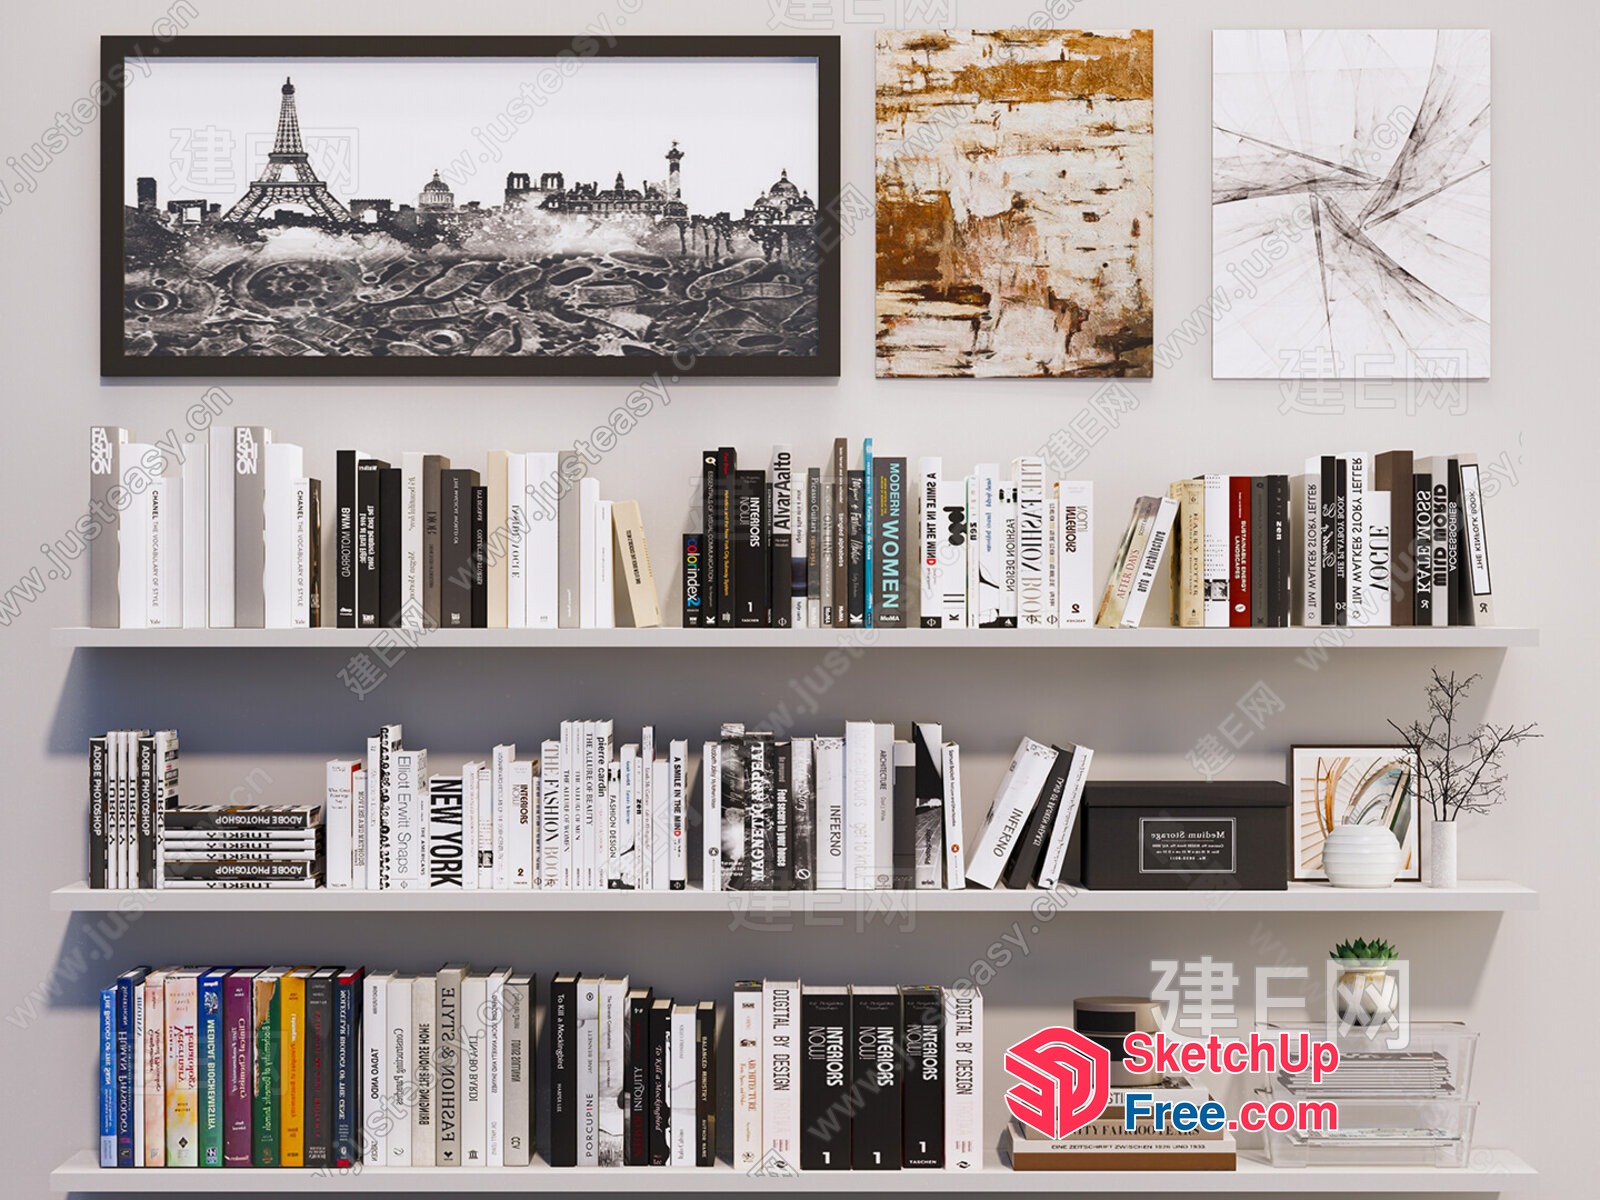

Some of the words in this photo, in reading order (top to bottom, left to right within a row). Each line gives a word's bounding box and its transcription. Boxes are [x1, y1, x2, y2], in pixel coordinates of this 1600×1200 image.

[773, 452, 791, 531] AlvarAalto
[890, 463, 900, 516] MODERN
[750, 497, 760, 548] INTERIORS
[687, 539, 701, 607] colorindex2
[882, 520, 899, 609] WOMEN
[1116, 572, 1133, 599] AFTER
[1127, 549, 1140, 572] DAYS
[93, 745, 102, 778] ADOBE
[141, 745, 150, 778] ADOBE
[597, 737, 607, 765] pierre
[396, 756, 411, 789] Elliott
[597, 767, 607, 798] cardin
[93, 779, 102, 836] PHOTOSHOP
[141, 779, 150, 836] PHOTOSHOP
[396, 793, 411, 828] Erwitt
[430, 780, 463, 825] NEW
[520, 784, 528, 825] INTERIORS
[674, 789, 681, 798] IN
[777, 789, 787, 802] Feel
[215, 816, 270, 824] PHOTOSHOP
[272, 816, 303, 824] ADOBE
[777, 803, 787, 824] secure
[777, 832, 787, 847] your
[830, 805, 841, 857] INFERNO
[993, 807, 1024, 858] INFERNO
[215, 866, 270, 874] PHOTOSHOP
[272, 866, 303, 874] ADOBE
[396, 832, 411, 874] Snaps
[430, 831, 463, 888] YORK
[777, 847, 787, 867] house
[555, 994, 565, 1003] To
[555, 1004, 565, 1016] Kill
[773, 989, 790, 1030] DIGITAL
[956, 998, 973, 1036] DIGITAL
[555, 1024, 565, 1070] Mockingbird
[773, 1035, 790, 1048] BY
[809, 1027, 825, 1060] NOW!
[827, 1027, 843, 1087] INTERIORS
[860, 1027, 876, 1060] NOW!
[878, 1027, 893, 1087] INTERIORS
[906, 1025, 922, 1056] NOW!
[923, 1025, 938, 1081] INTERIORS
[956, 1042, 973, 1054] BY
[633, 1066, 643, 1112] INIQUITY
[773, 1053, 790, 1091] DESIGN
[956, 1060, 973, 1096] DESIGN
[823, 1152, 830, 1164] 1
[873, 1152, 880, 1164] 1
[919, 1141, 926, 1153] 1
